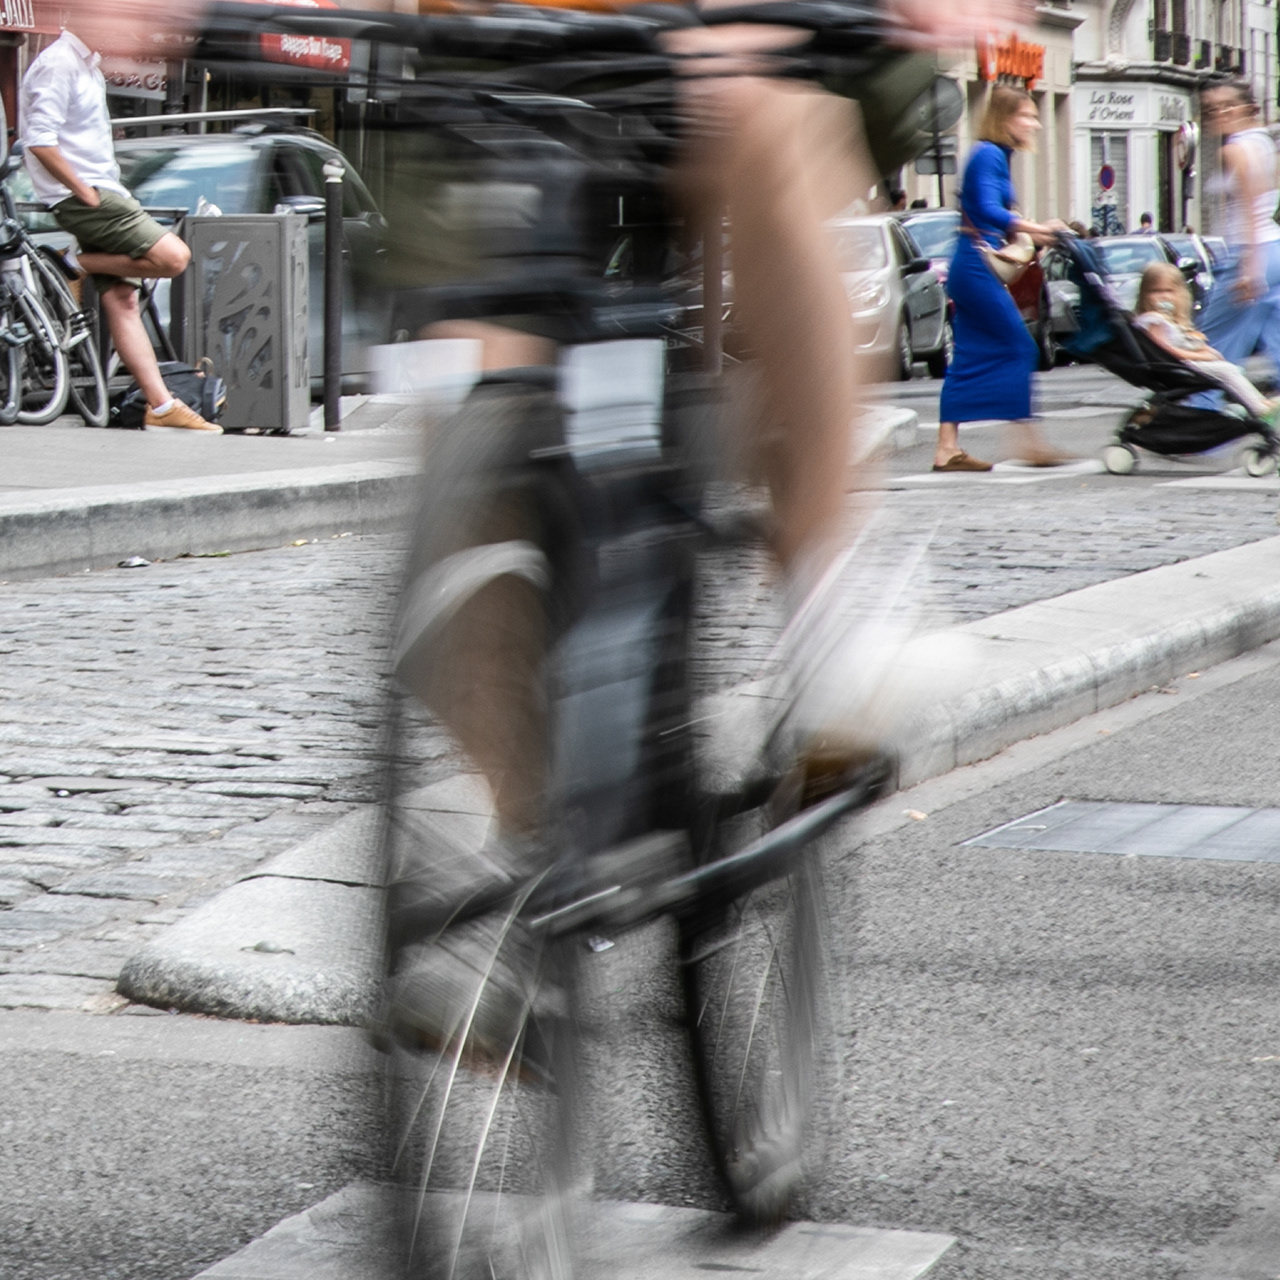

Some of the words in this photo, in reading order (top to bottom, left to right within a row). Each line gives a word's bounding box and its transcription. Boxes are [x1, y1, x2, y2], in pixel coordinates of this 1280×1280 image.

[1089, 90, 1106, 105] La
[1107, 91, 1135, 105] Rose
[1089, 106, 1135, 121] d'Orient
